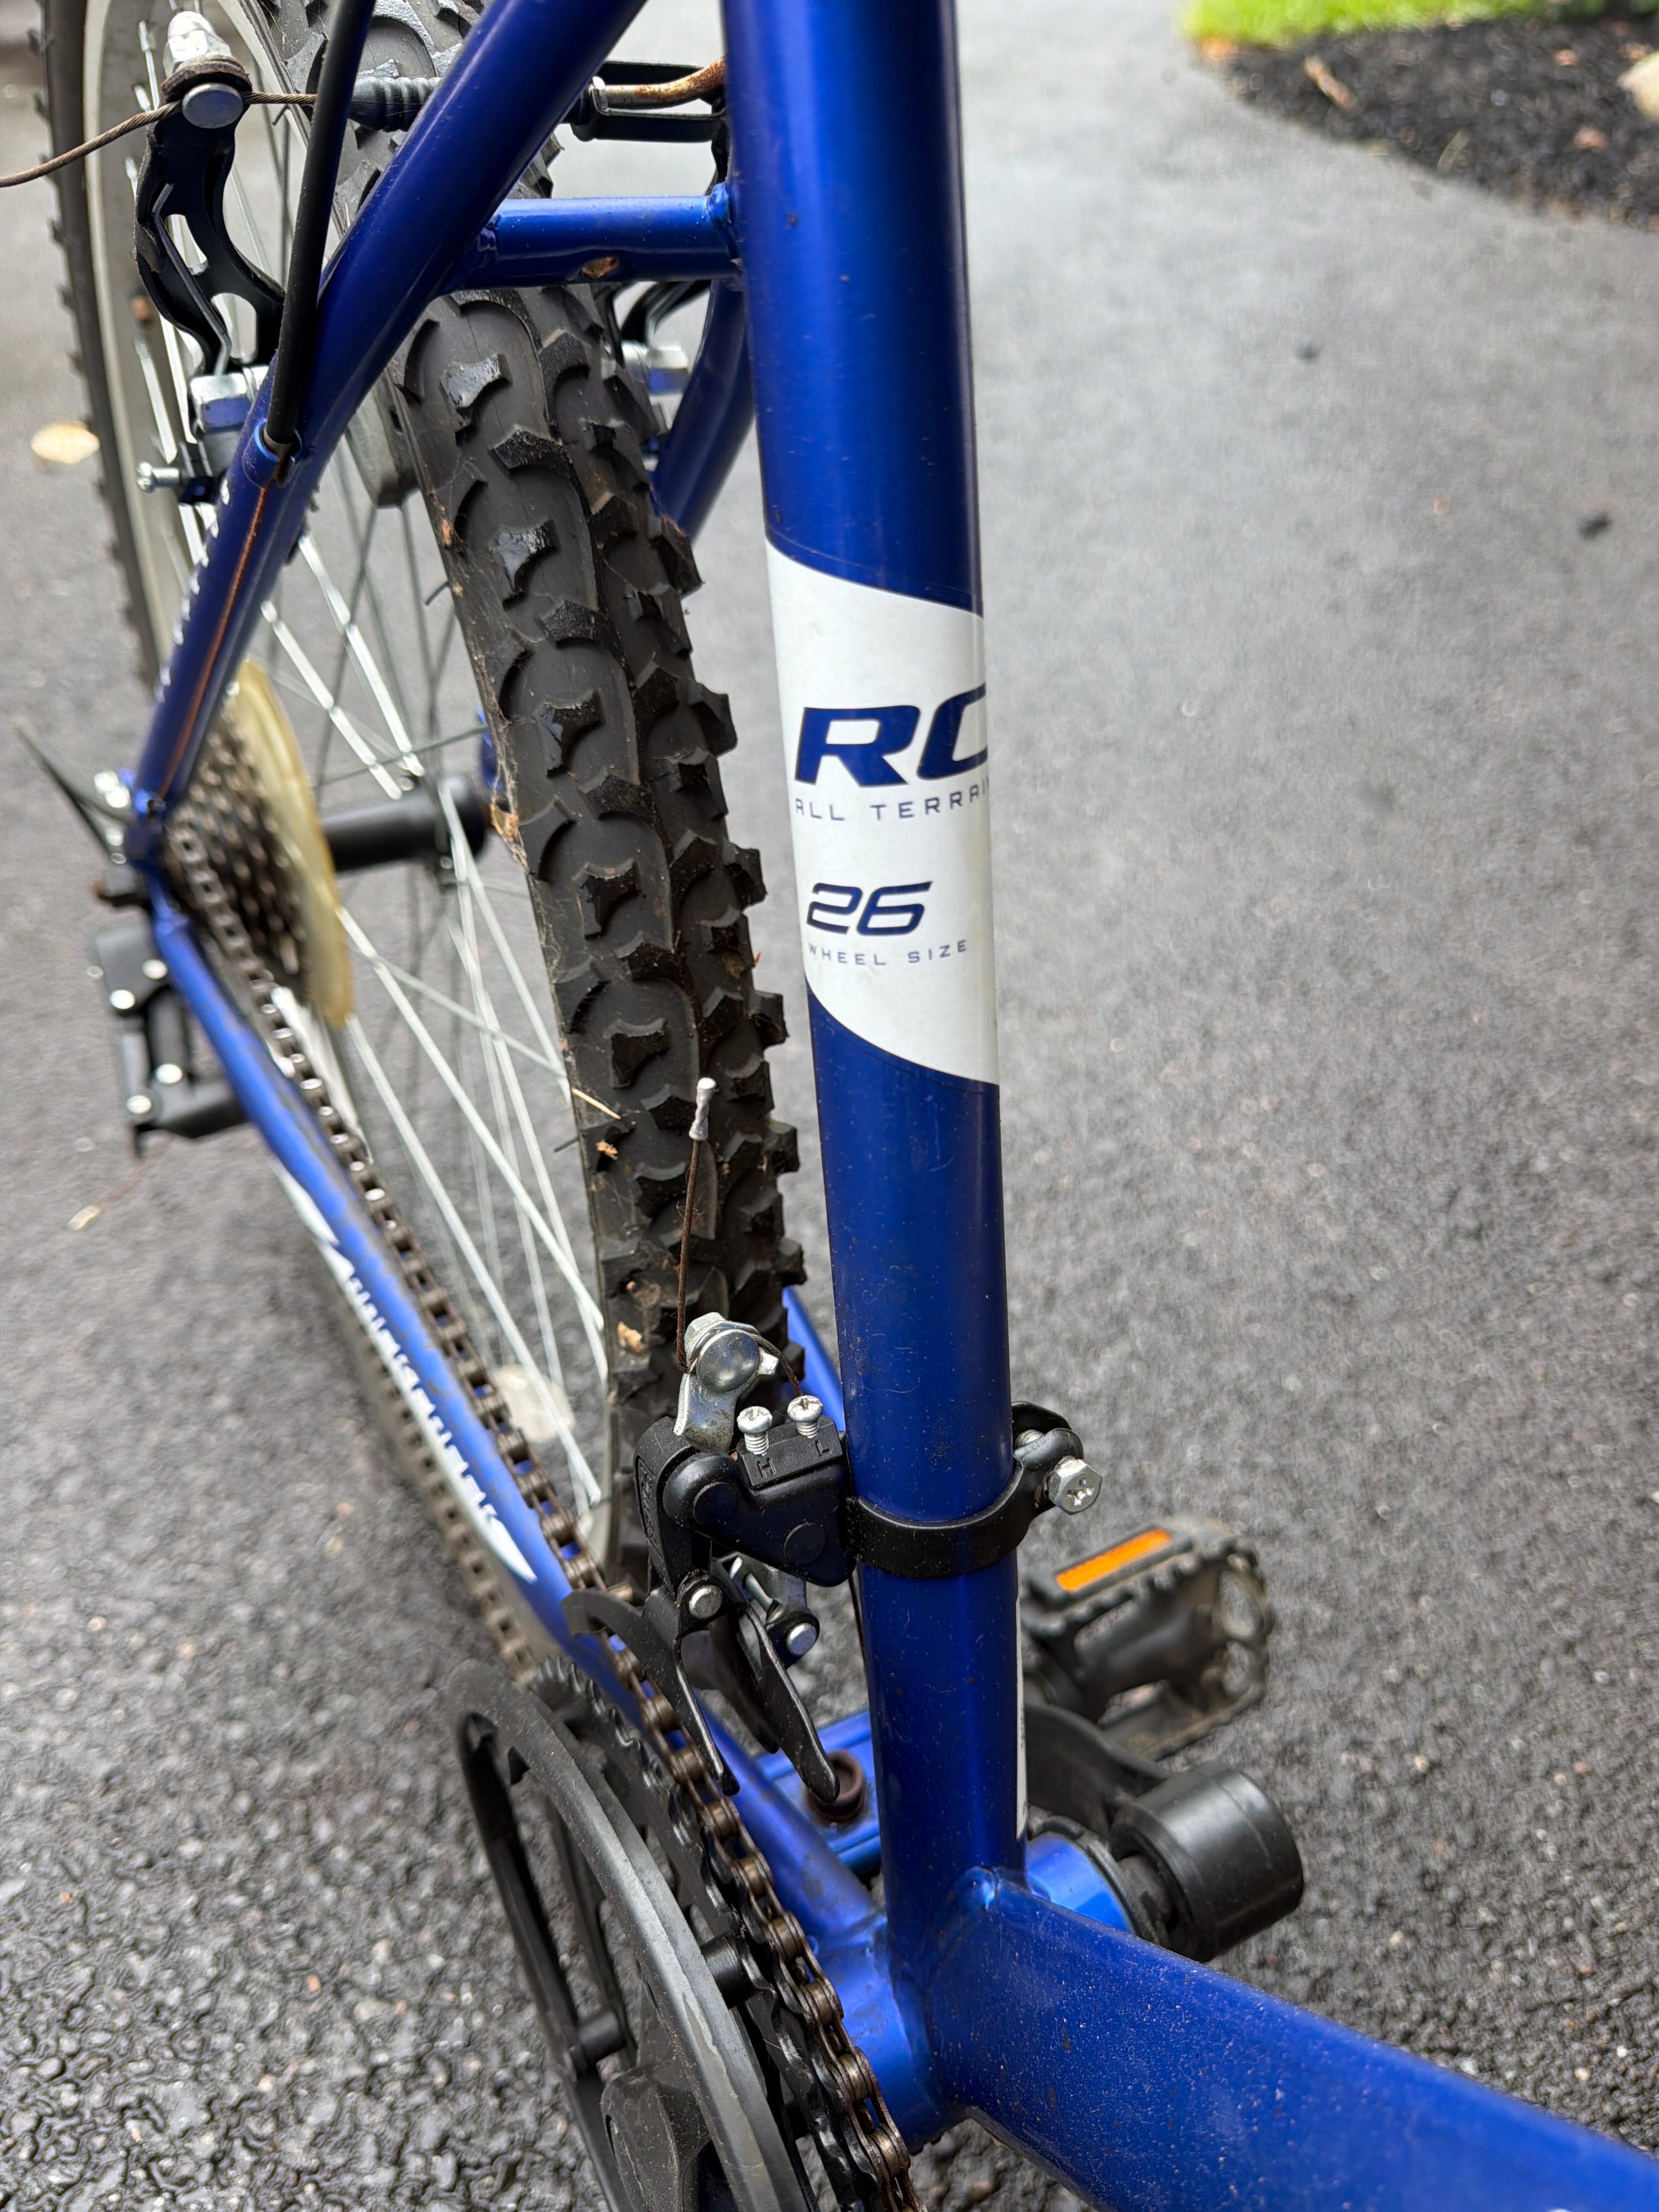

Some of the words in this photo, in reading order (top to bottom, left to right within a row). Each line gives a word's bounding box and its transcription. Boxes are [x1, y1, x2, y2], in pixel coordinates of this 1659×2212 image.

[795, 798, 846, 822] ALL
[806, 881, 933, 936] 26
[808, 943, 887, 966] WHEEL
[907, 940, 967, 964] SIZE
[815, 1439, 833, 1458] L
[757, 1457, 777, 1479] H
